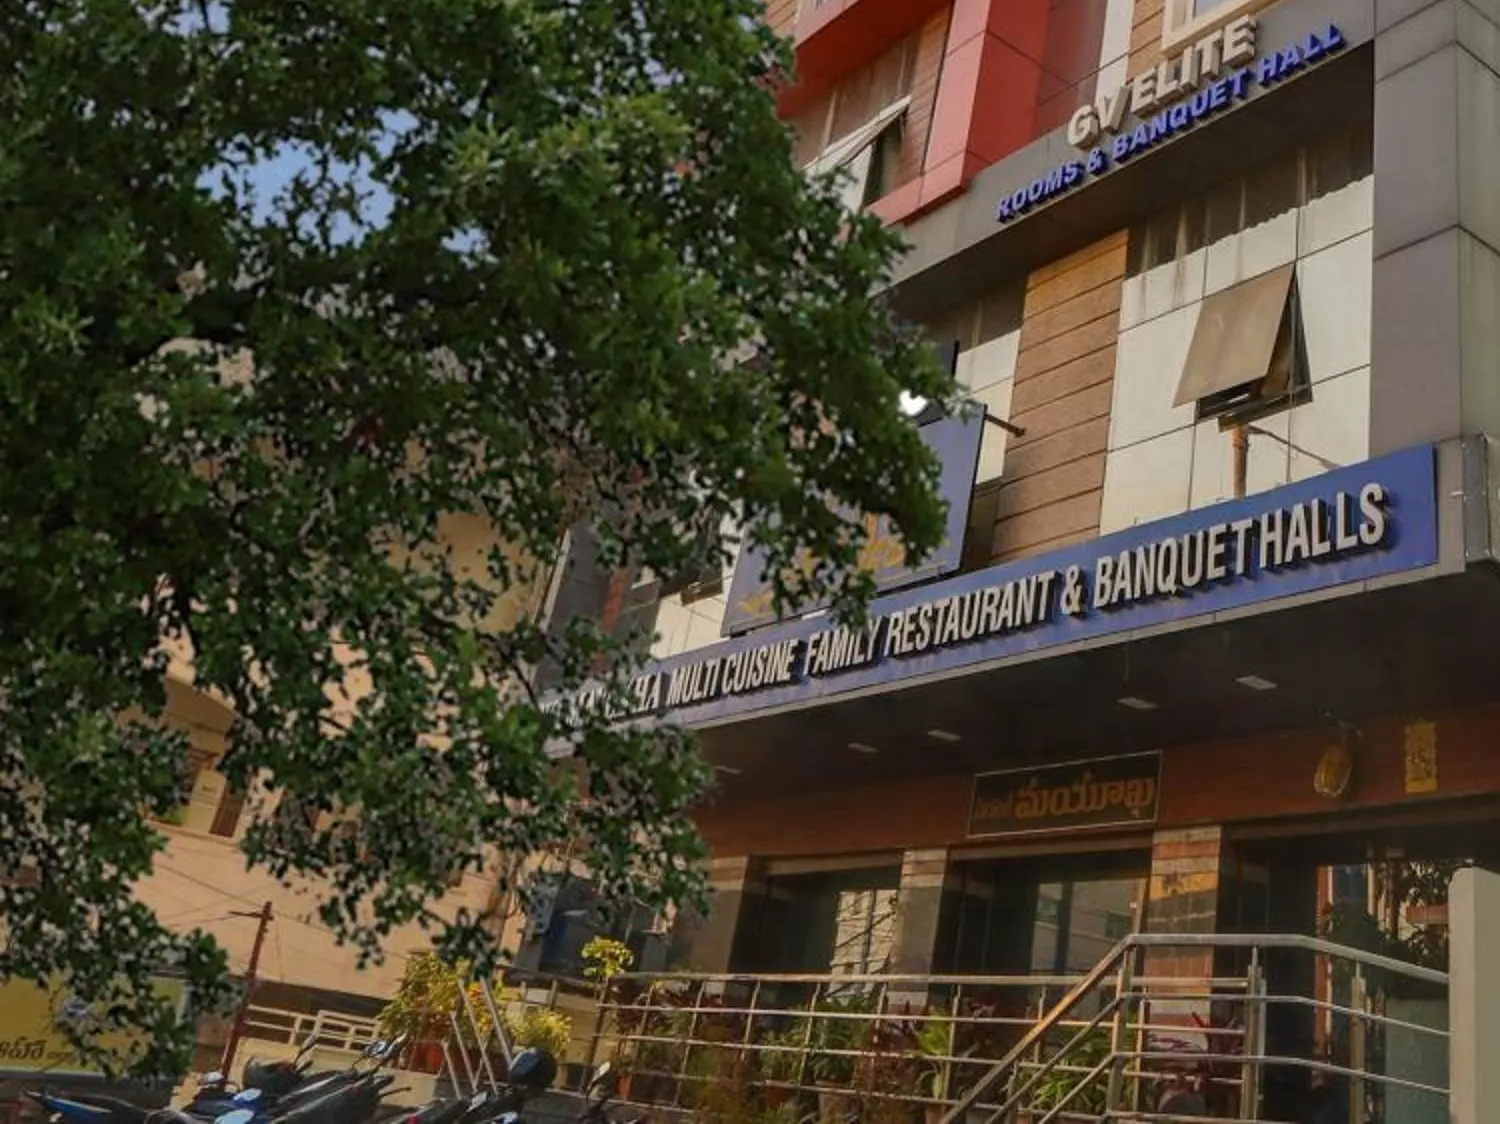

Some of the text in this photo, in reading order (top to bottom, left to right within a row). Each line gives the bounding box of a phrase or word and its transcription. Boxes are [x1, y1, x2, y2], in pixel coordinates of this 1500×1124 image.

[996, 20, 1348, 223] ROOMS & BANQUET HALL
[1068, 14, 1257, 149] GV ELITE
[665, 659, 720, 709] MULTI
[721, 637, 799, 694] CUISINE
[803, 614, 883, 676] FAMILY
[883, 568, 1055, 657] RESTAURANT
[1060, 563, 1085, 617] &
[1093, 517, 1252, 598] BANQUET
[1258, 482, 1388, 569] HALLS
